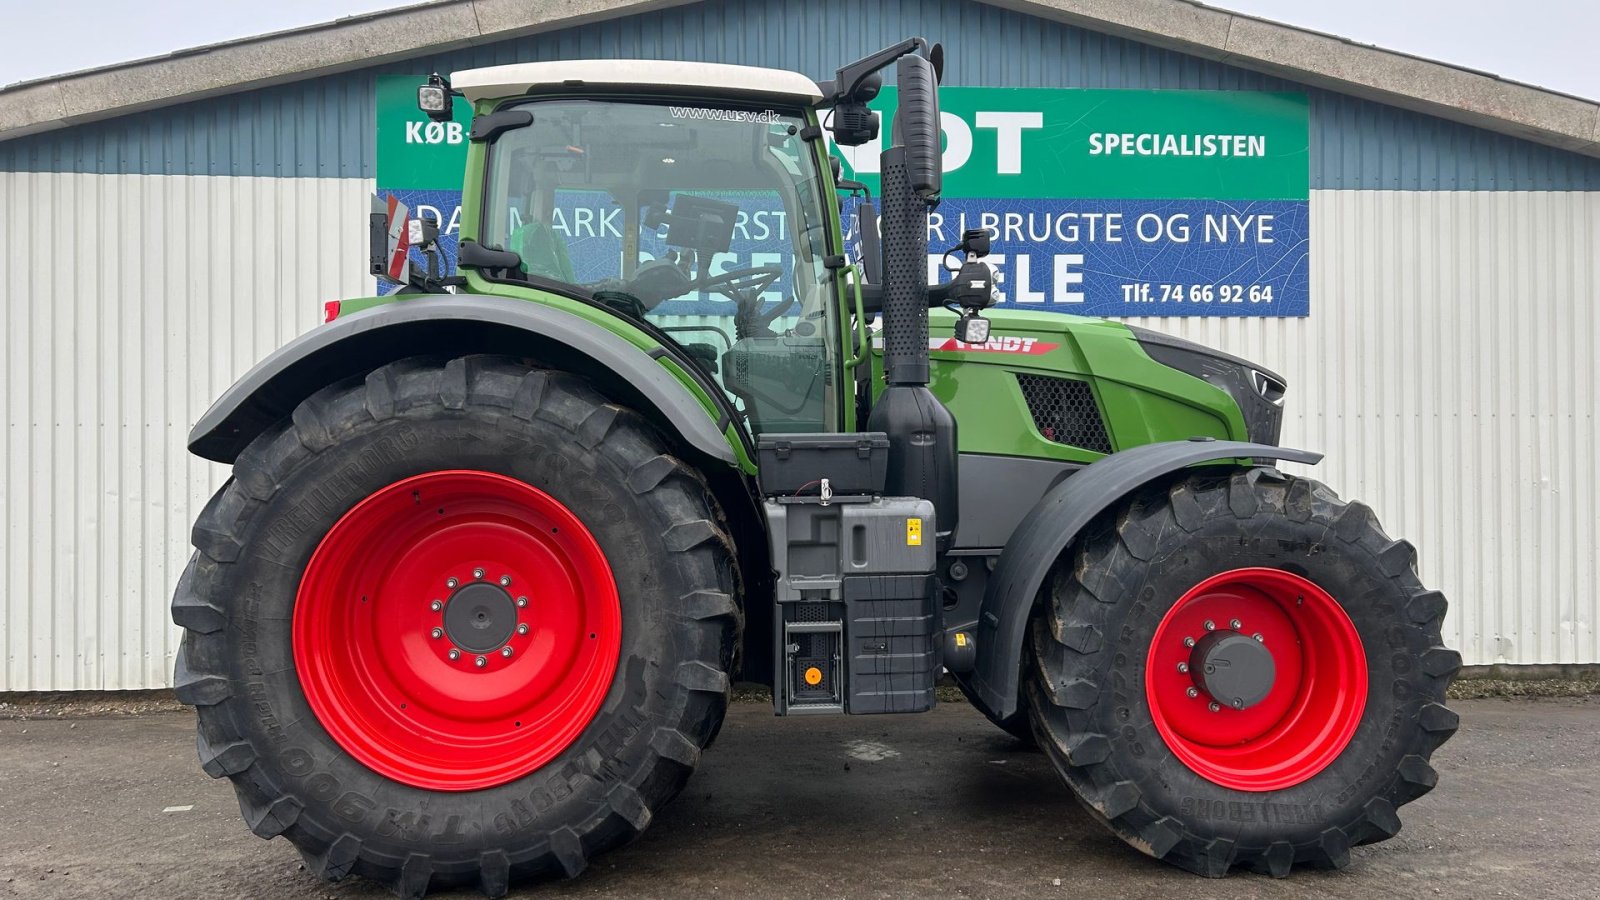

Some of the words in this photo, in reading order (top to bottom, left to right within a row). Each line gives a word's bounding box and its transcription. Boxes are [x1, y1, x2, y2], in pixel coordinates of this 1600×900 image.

[669, 106, 781, 124] www.usv.dk
[1088, 133, 1266, 157] SPECIALISTEN
[981, 212, 1122, 243] BRUGTE
[1136, 213, 1190, 243] OG
[1205, 214, 1274, 243] NYE
[1121, 284, 1154, 303] Tlf.
[1160, 284, 1184, 303] 74
[1189, 284, 1214, 303] 66
[1219, 284, 1243, 303] 92
[1249, 284, 1273, 303] 64
